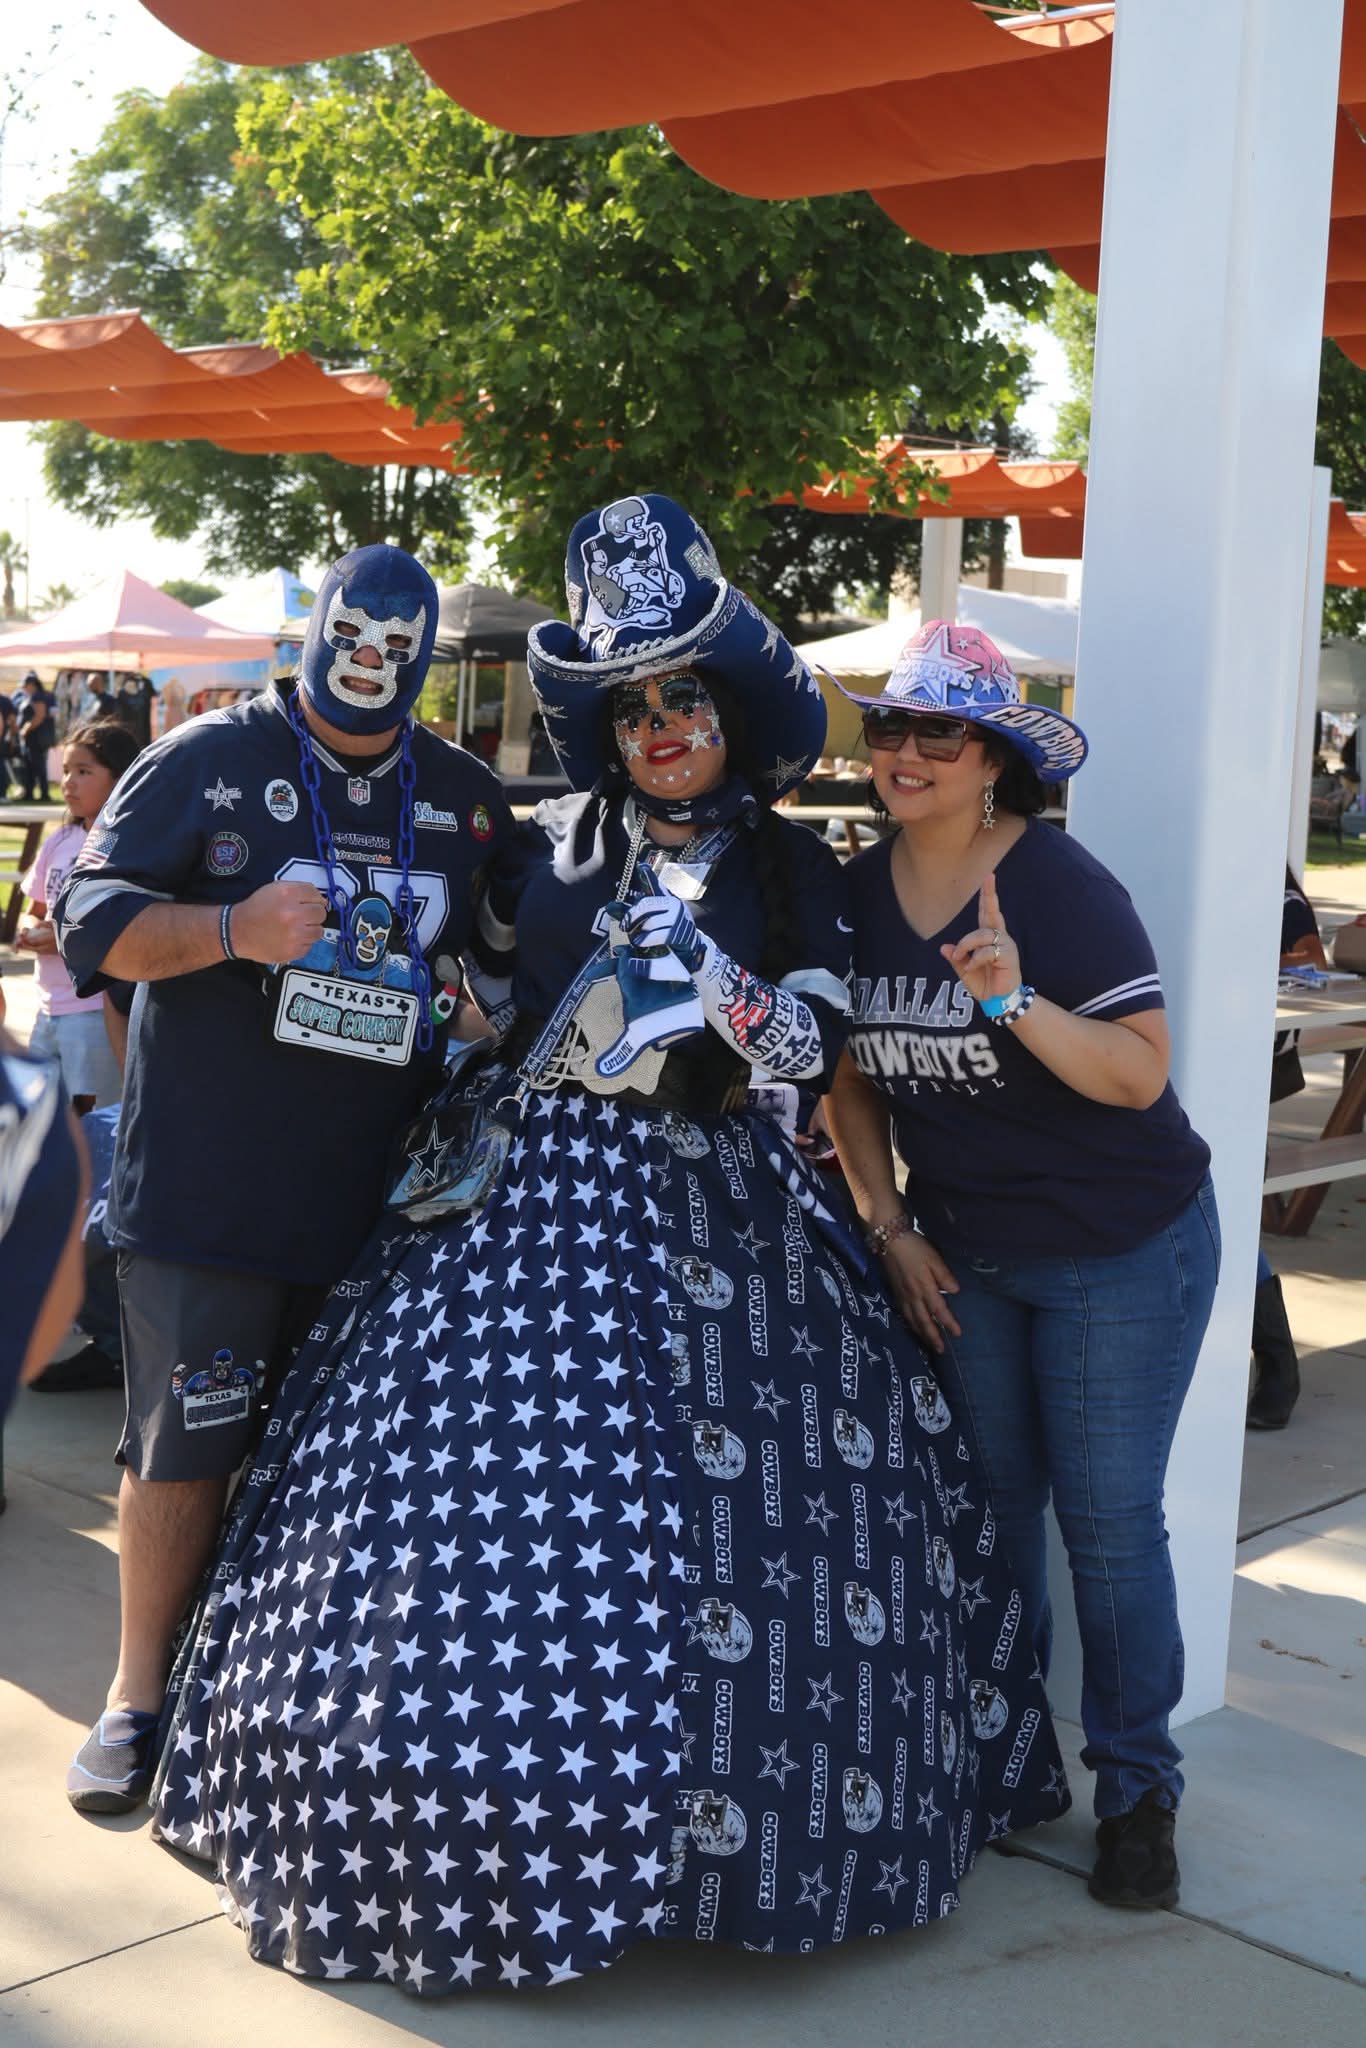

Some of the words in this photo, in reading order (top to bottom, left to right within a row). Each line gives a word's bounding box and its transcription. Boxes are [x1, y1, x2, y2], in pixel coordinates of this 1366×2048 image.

[894, 660, 976, 690] OWBOYS
[979, 706, 1085, 769] COWBOYS
[351, 788, 367, 801] NFL
[422, 811, 456, 823] SIRENA
[332, 833, 390, 849] COWBOYS
[288, 994, 341, 1035] SUPER
[341, 1010, 407, 1045] COWBOY
[323, 985, 385, 1007] TEXAS
[747, 988, 793, 1059] ERICA'S
[852, 976, 974, 1027] DALLAS
[780, 1036, 822, 1077] DEM
[850, 1030, 1000, 1081] OWBOYS
[714, 1130, 748, 1199] COWBOYS
[748, 1275, 768, 1356] COWBOYS
[205, 1391, 232, 1403] TEXAS
[703, 1323, 725, 1407] COWBOYS
[801, 1384, 821, 1468] COWBOYS
[761, 1440, 782, 1527] COWBOYS
[712, 1496, 733, 1584] COWBOYS
[851, 1483, 870, 1570] COWBOYS
[813, 1556, 830, 1647] COWBOYS
[891, 1556, 905, 1644] COWBOYS
[992, 1589, 1022, 1671] COWBOYS
[769, 1620, 786, 1712] COWBOYS
[712, 1679, 734, 1774] COWBOYS
[858, 1662, 872, 1754] COWBOYS
[923, 1676, 935, 1766] COWBOYS
[1003, 1708, 1040, 1788] COWBOYS
[809, 1743, 828, 1838] COWBOYS
[892, 1737, 907, 1830] COWBOYS
[758, 1811, 778, 1909] COWBOYS
[833, 1850, 857, 1942] COWBOYS
[696, 1872, 720, 1940] COWBO
